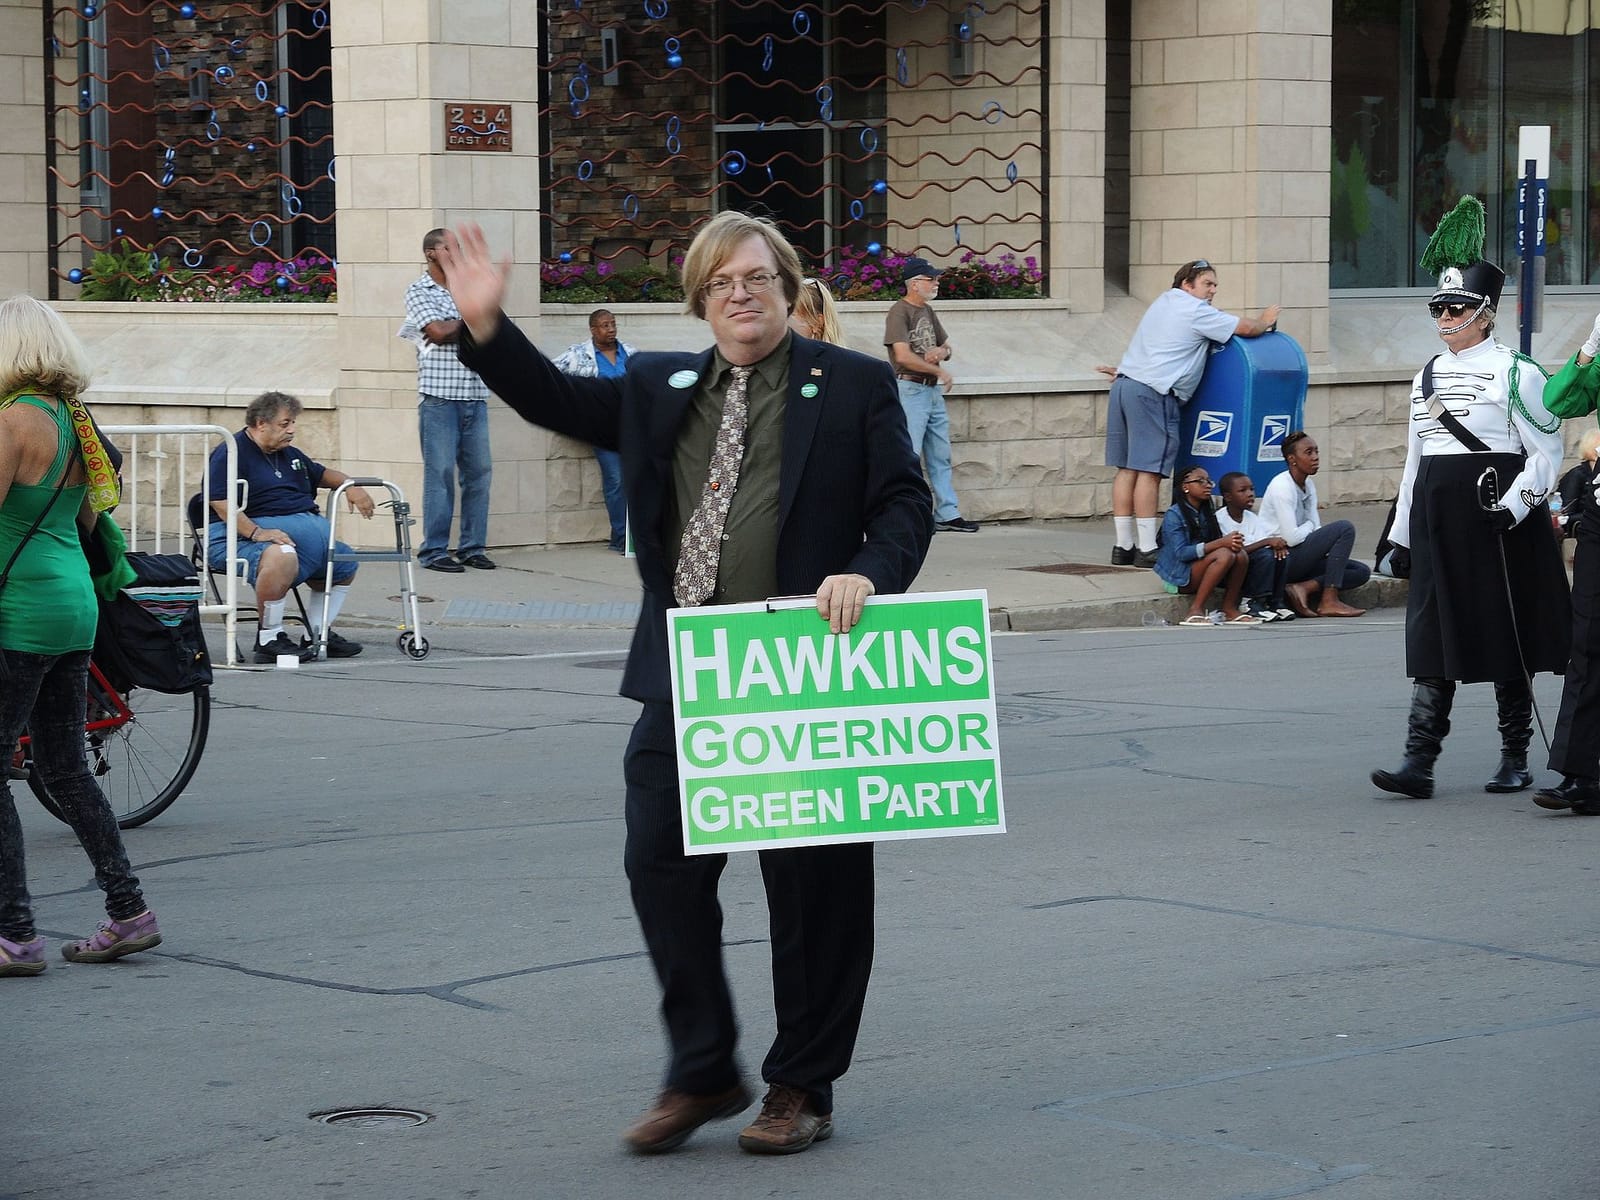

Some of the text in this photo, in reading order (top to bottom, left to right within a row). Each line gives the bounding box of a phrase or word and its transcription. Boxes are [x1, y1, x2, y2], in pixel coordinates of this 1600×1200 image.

[449, 136, 509, 145] EAST AVE
[451, 108, 508, 124] 234
[1536, 188, 1545, 246] STOP
[679, 625, 985, 703] HAWKINS
[682, 713, 992, 769] GOVERNOR
[690, 775, 993, 832] GREEN PARTY
